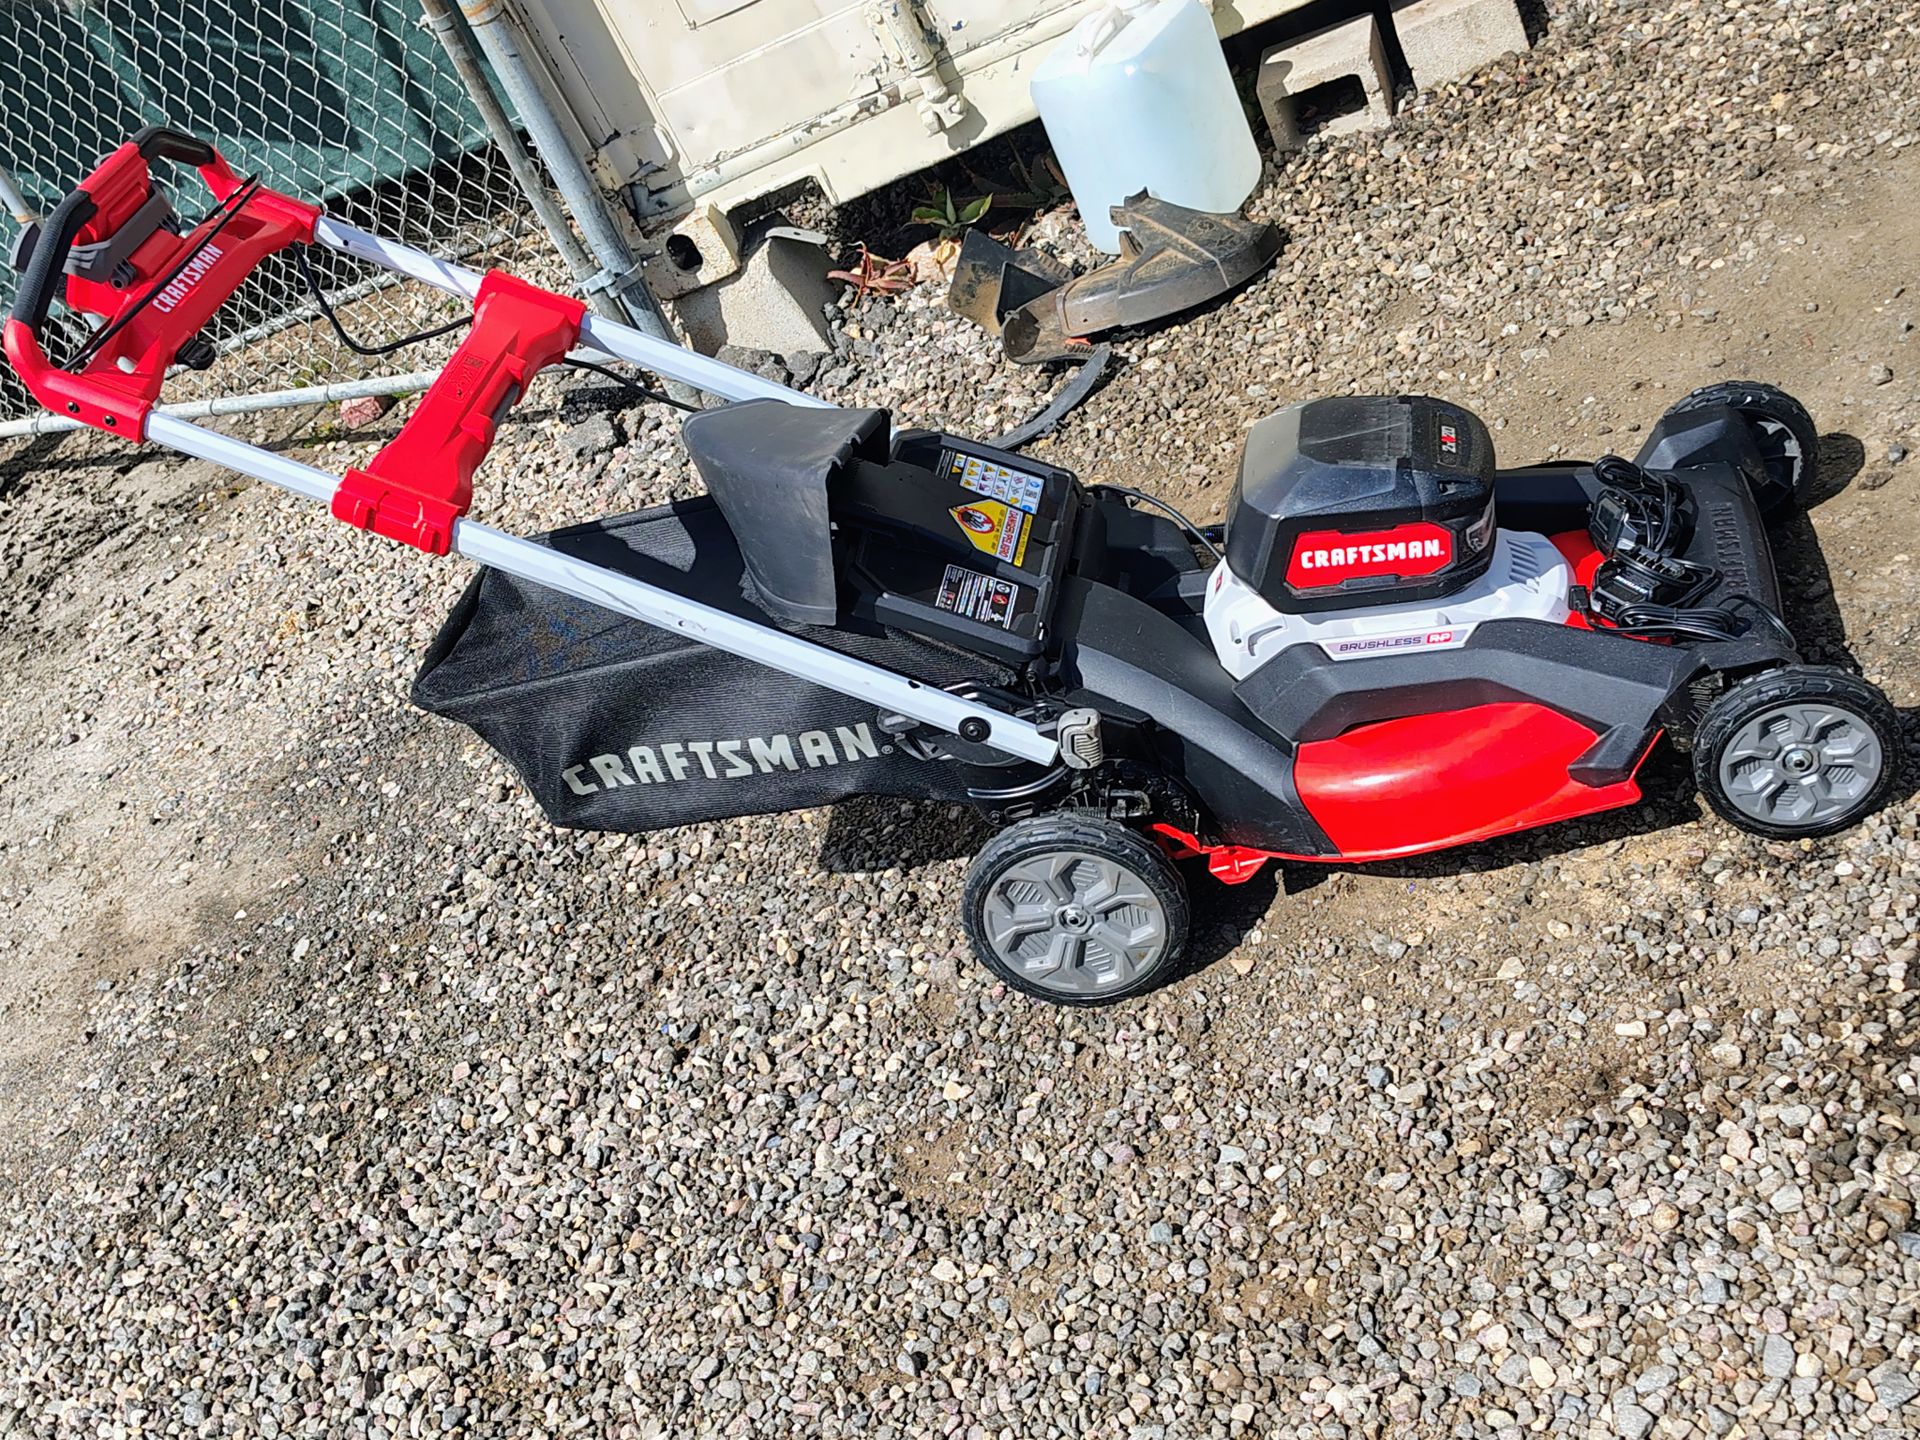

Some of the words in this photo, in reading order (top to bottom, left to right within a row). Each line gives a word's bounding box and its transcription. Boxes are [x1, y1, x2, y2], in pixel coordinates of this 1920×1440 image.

[152, 243, 223, 313] CRAFTSMAN
[1301, 540, 1440, 569] CRAFTSMAN
[1340, 636, 1421, 652] BRUSHLESS
[562, 722, 880, 796] CRAFTSMAN
